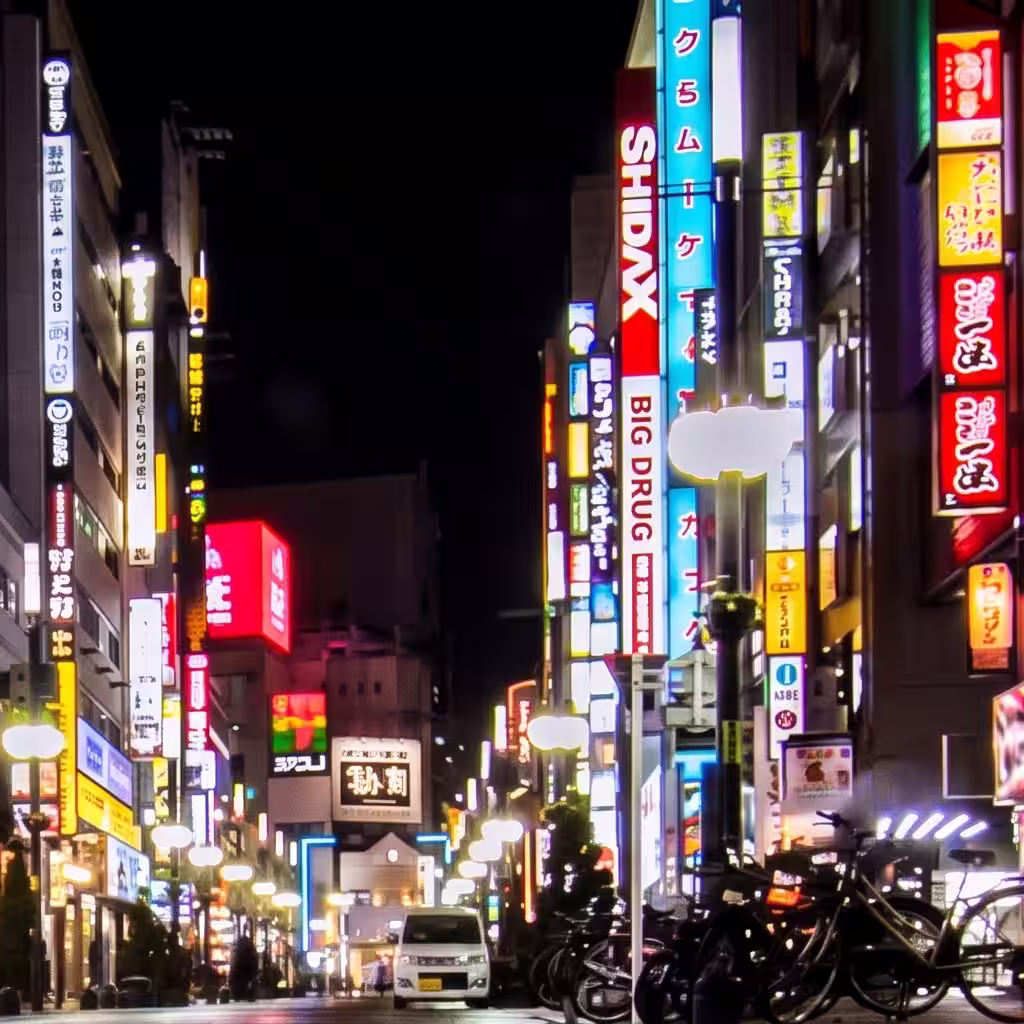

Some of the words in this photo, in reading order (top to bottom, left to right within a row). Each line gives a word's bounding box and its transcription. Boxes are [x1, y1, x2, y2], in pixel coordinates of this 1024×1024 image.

[620, 125, 658, 323] SHIDAX
[631, 396, 652, 445] BIG
[631, 457, 653, 541] DRUG
